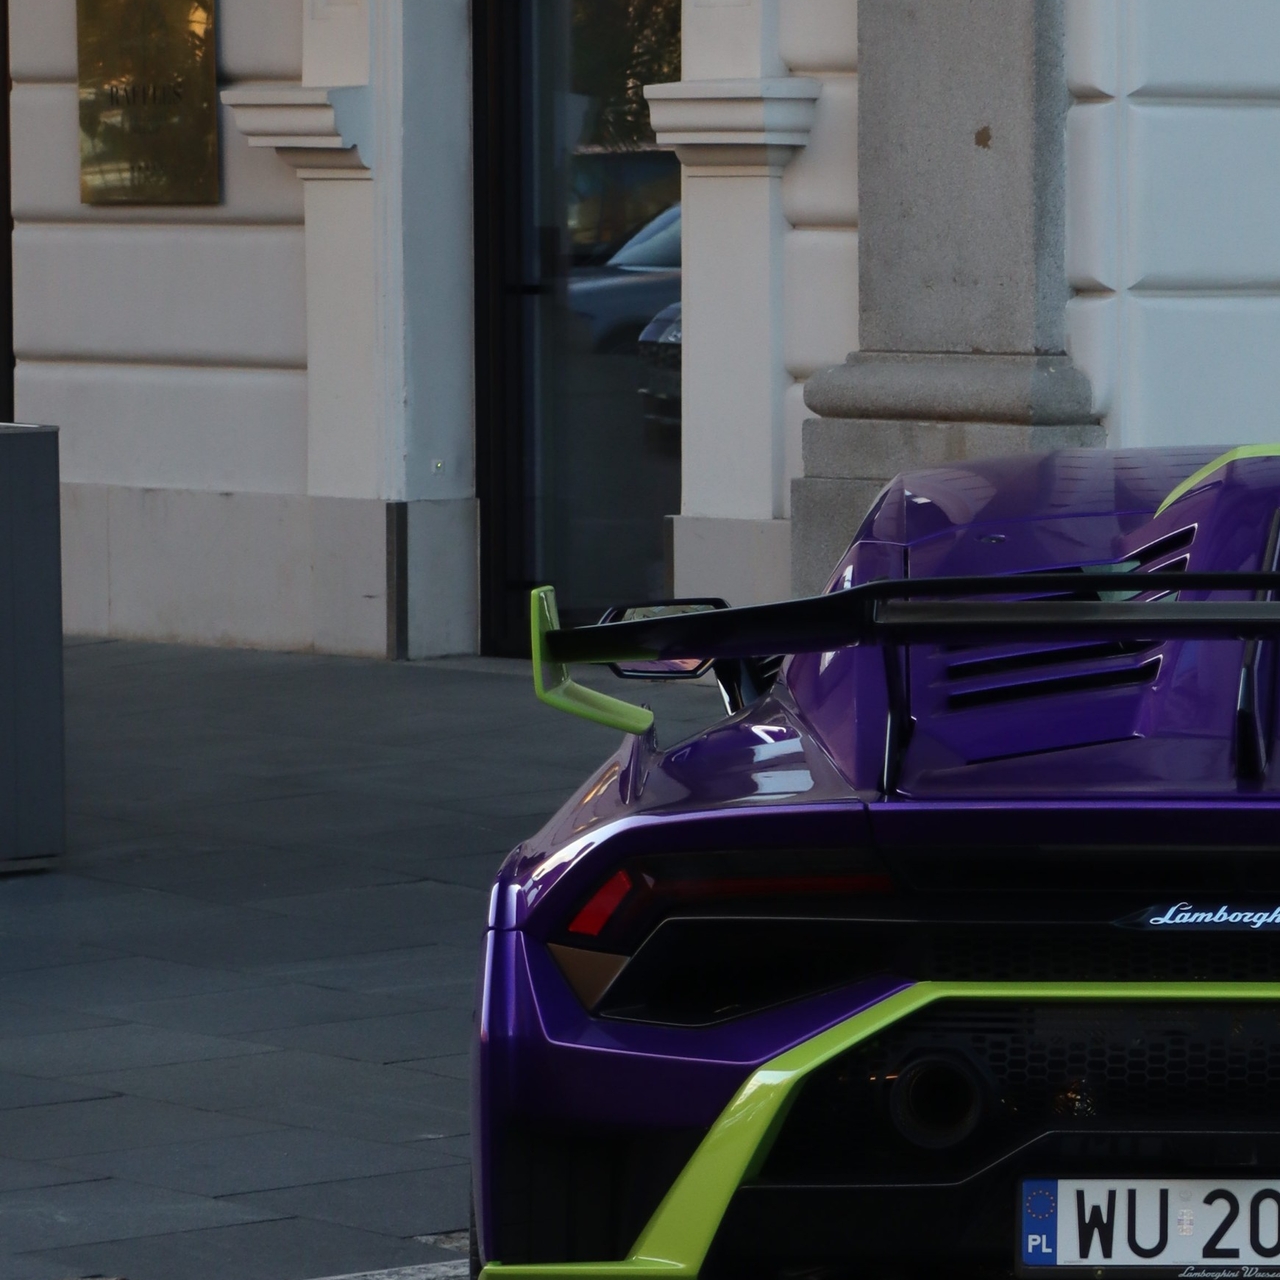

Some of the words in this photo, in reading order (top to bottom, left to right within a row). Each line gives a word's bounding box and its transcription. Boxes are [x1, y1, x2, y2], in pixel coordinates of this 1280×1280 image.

[1076, 1188, 1169, 1259] WU
[1028, 1235, 1052, 1253] PL
[1178, 1265, 1240, 1280] Lamborghini
